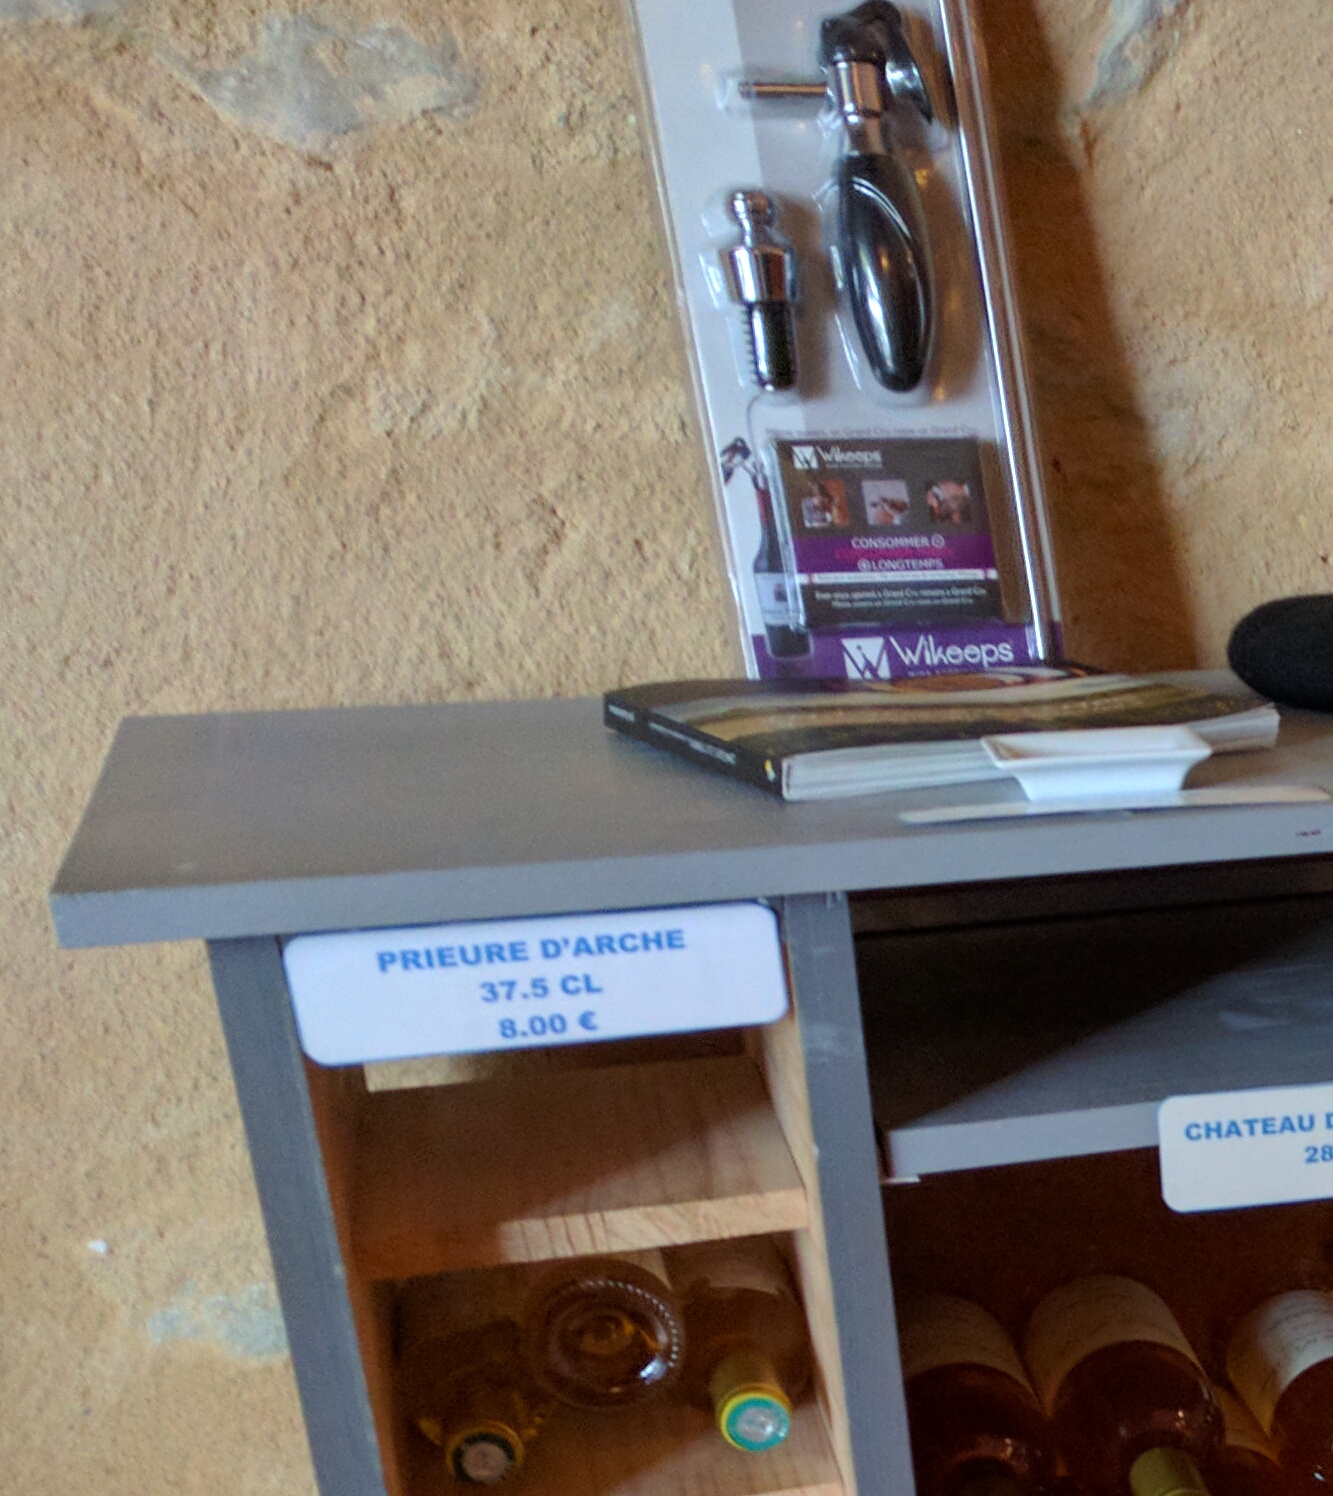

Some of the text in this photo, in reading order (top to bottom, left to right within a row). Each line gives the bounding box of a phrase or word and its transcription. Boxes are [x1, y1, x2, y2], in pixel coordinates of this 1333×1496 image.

[851, 535, 930, 549] CONSOMMER
[871, 557, 944, 572] LONGTEMPS
[376, 927, 688, 974] PRIEURE D'ARCHE
[479, 972, 604, 1004] 37.5 CL
[499, 1010, 599, 1040] 8.00 €
[1184, 1113, 1317, 1142] CHATEAU
